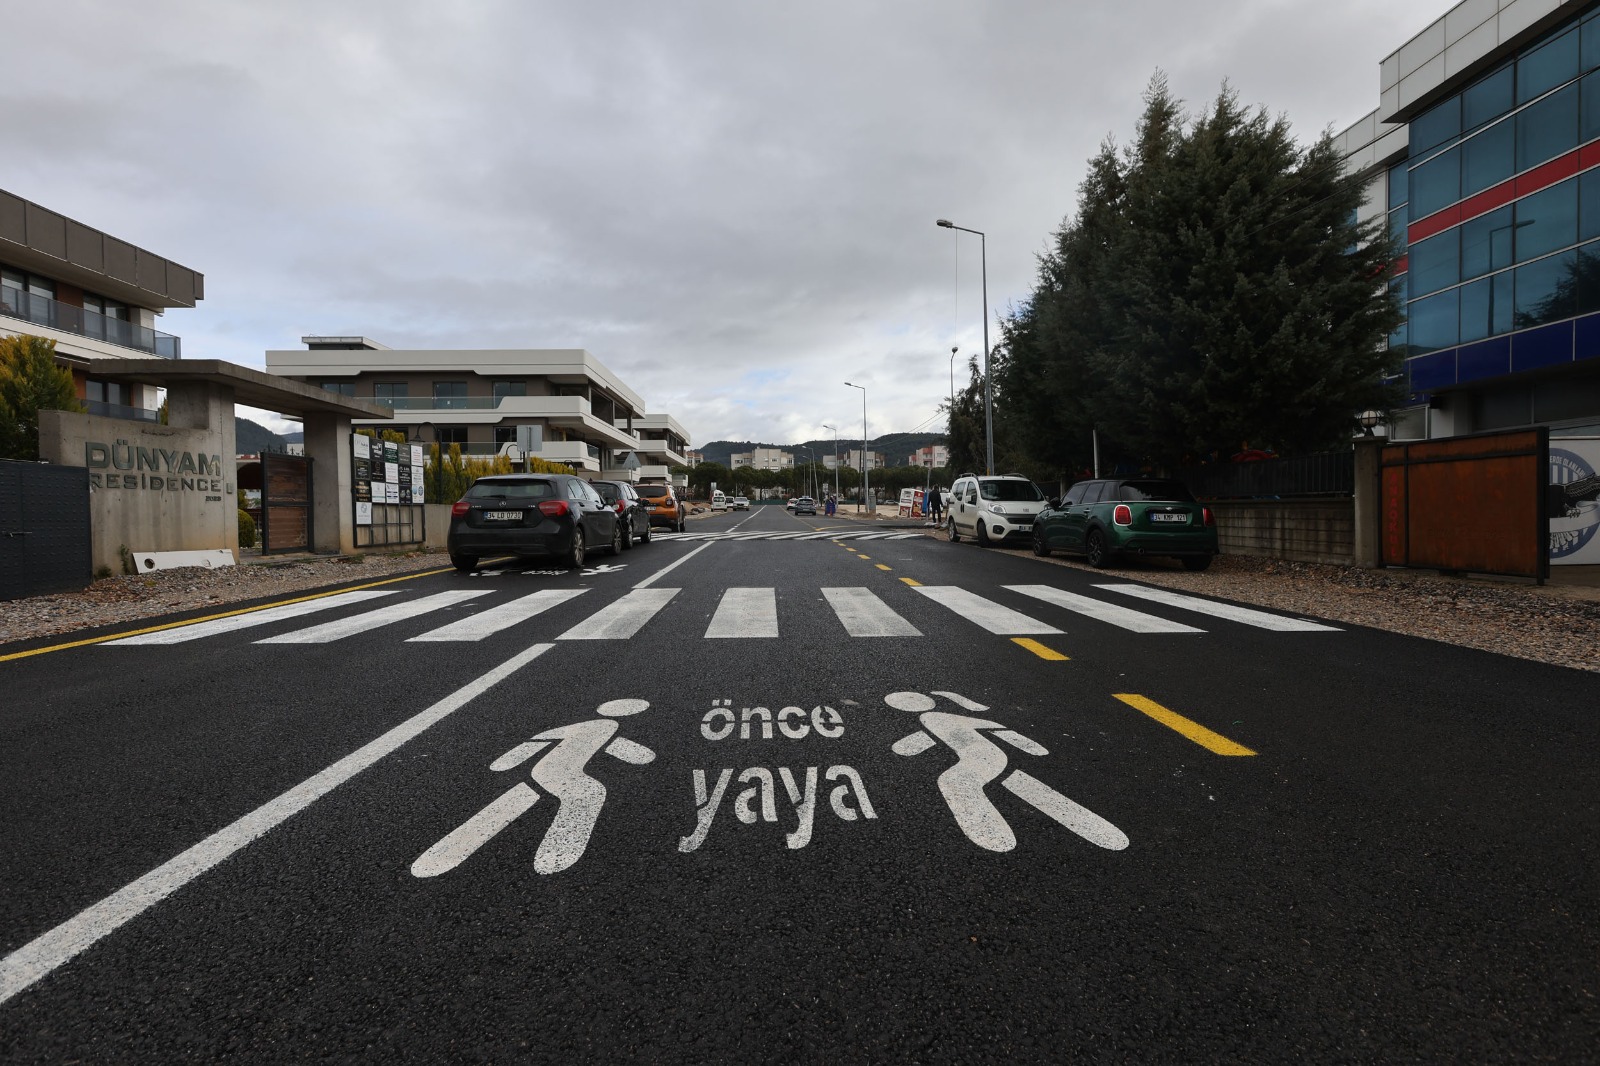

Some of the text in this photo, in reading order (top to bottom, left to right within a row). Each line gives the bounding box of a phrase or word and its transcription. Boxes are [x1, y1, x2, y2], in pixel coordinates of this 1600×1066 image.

[85, 439, 221, 476] DÜNYAM
[701, 699, 845, 741] önce
[678, 765, 878, 852] yaya
